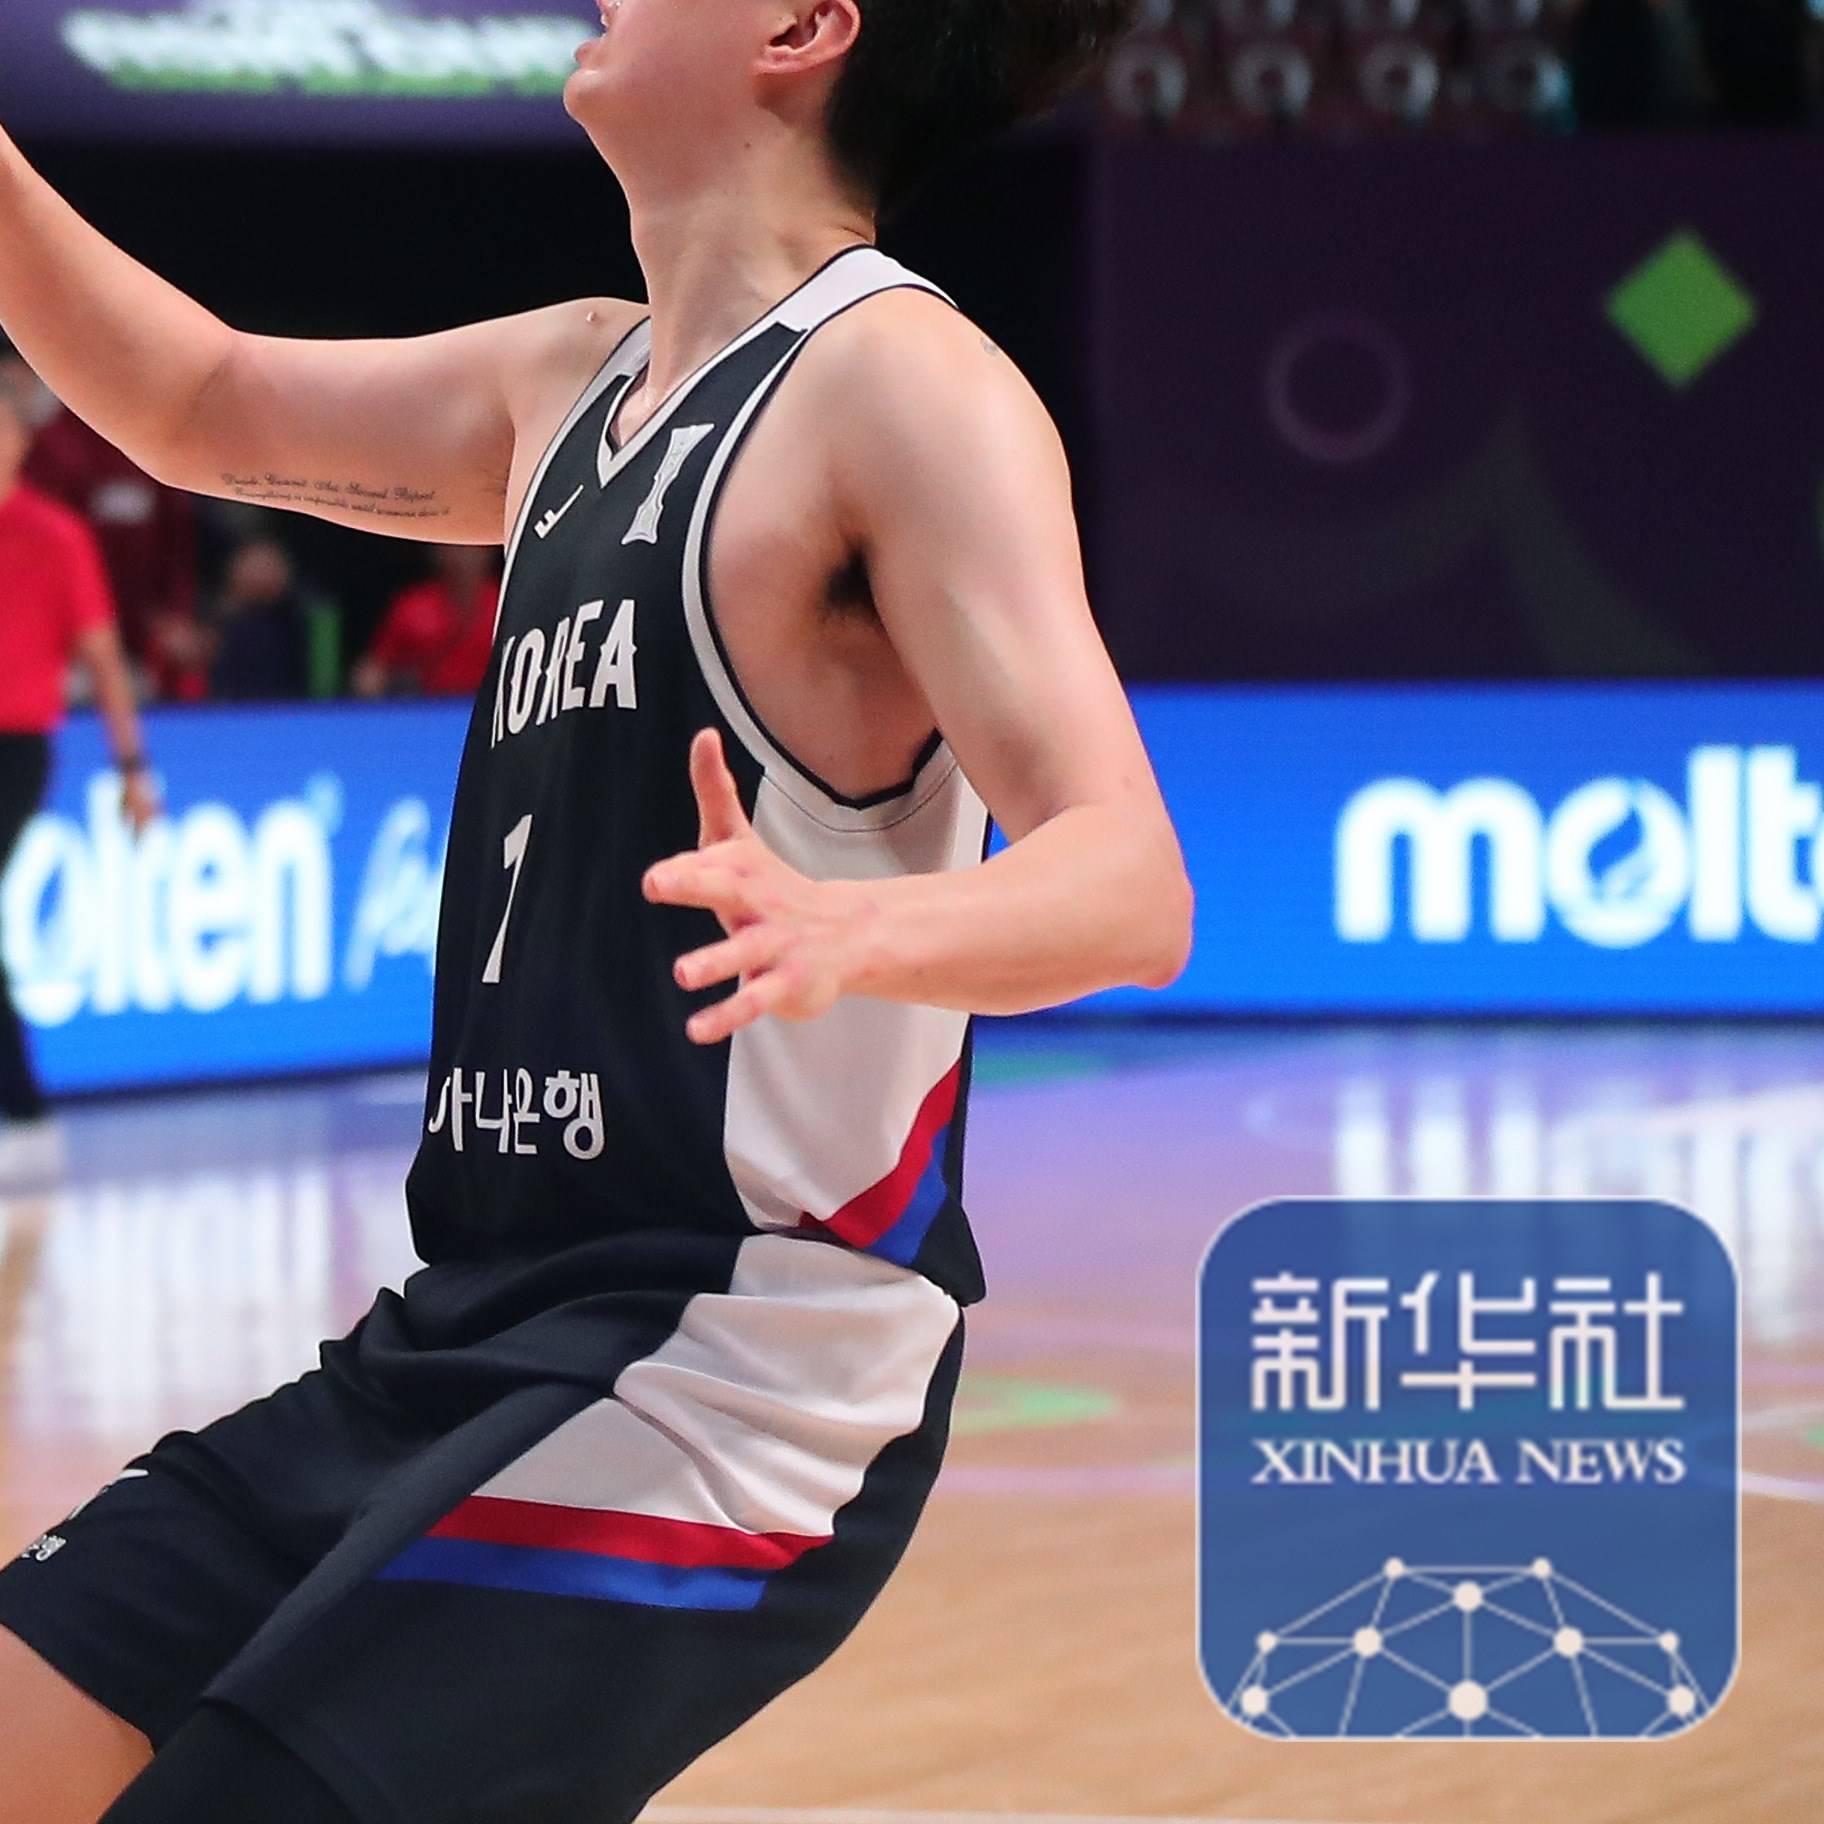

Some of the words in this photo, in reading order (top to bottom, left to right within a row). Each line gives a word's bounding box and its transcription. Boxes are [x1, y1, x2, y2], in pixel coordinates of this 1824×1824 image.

[491, 599, 637, 749] KOREA
[481, 813, 533, 984] 7
[1334, 744, 1824, 950] molt
